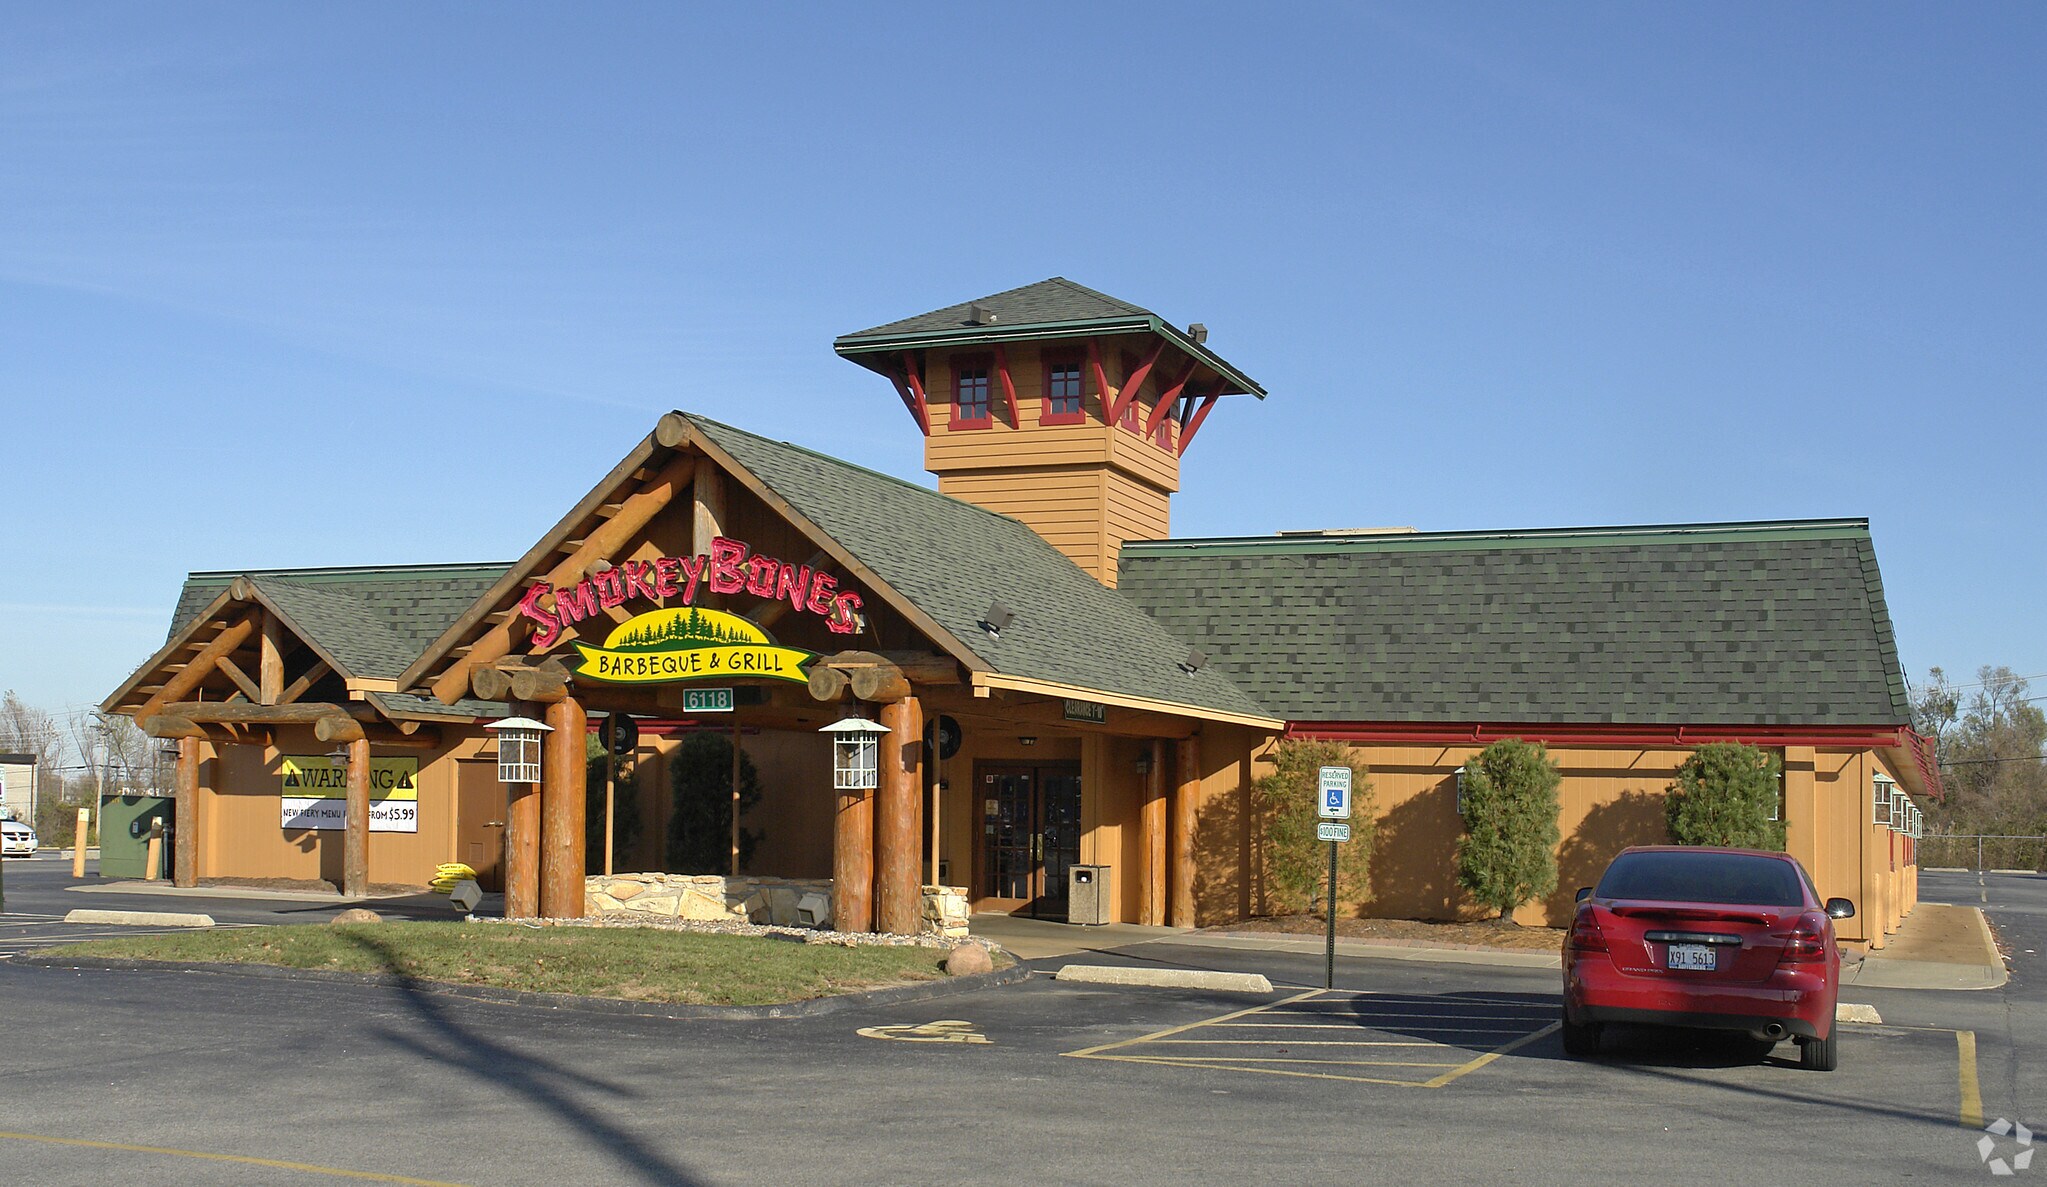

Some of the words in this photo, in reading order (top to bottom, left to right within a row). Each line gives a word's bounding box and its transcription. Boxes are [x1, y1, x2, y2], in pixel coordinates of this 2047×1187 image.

[599, 652, 702, 676] BARBEQUE
[709, 653, 721, 669] &
[729, 652, 783, 672] GRILL
[688, 691, 728, 709] 6118
[302, 768, 394, 788] WARNG
[283, 808, 298, 817] NEW
[300, 809, 319, 818] FIERY
[321, 809, 341, 818] MENU
[389, 807, 414, 821] $5.99
[1334, 827, 1347, 838] FINE
[1670, 951, 1686, 964] X91
[1692, 952, 1714, 965] 5613
